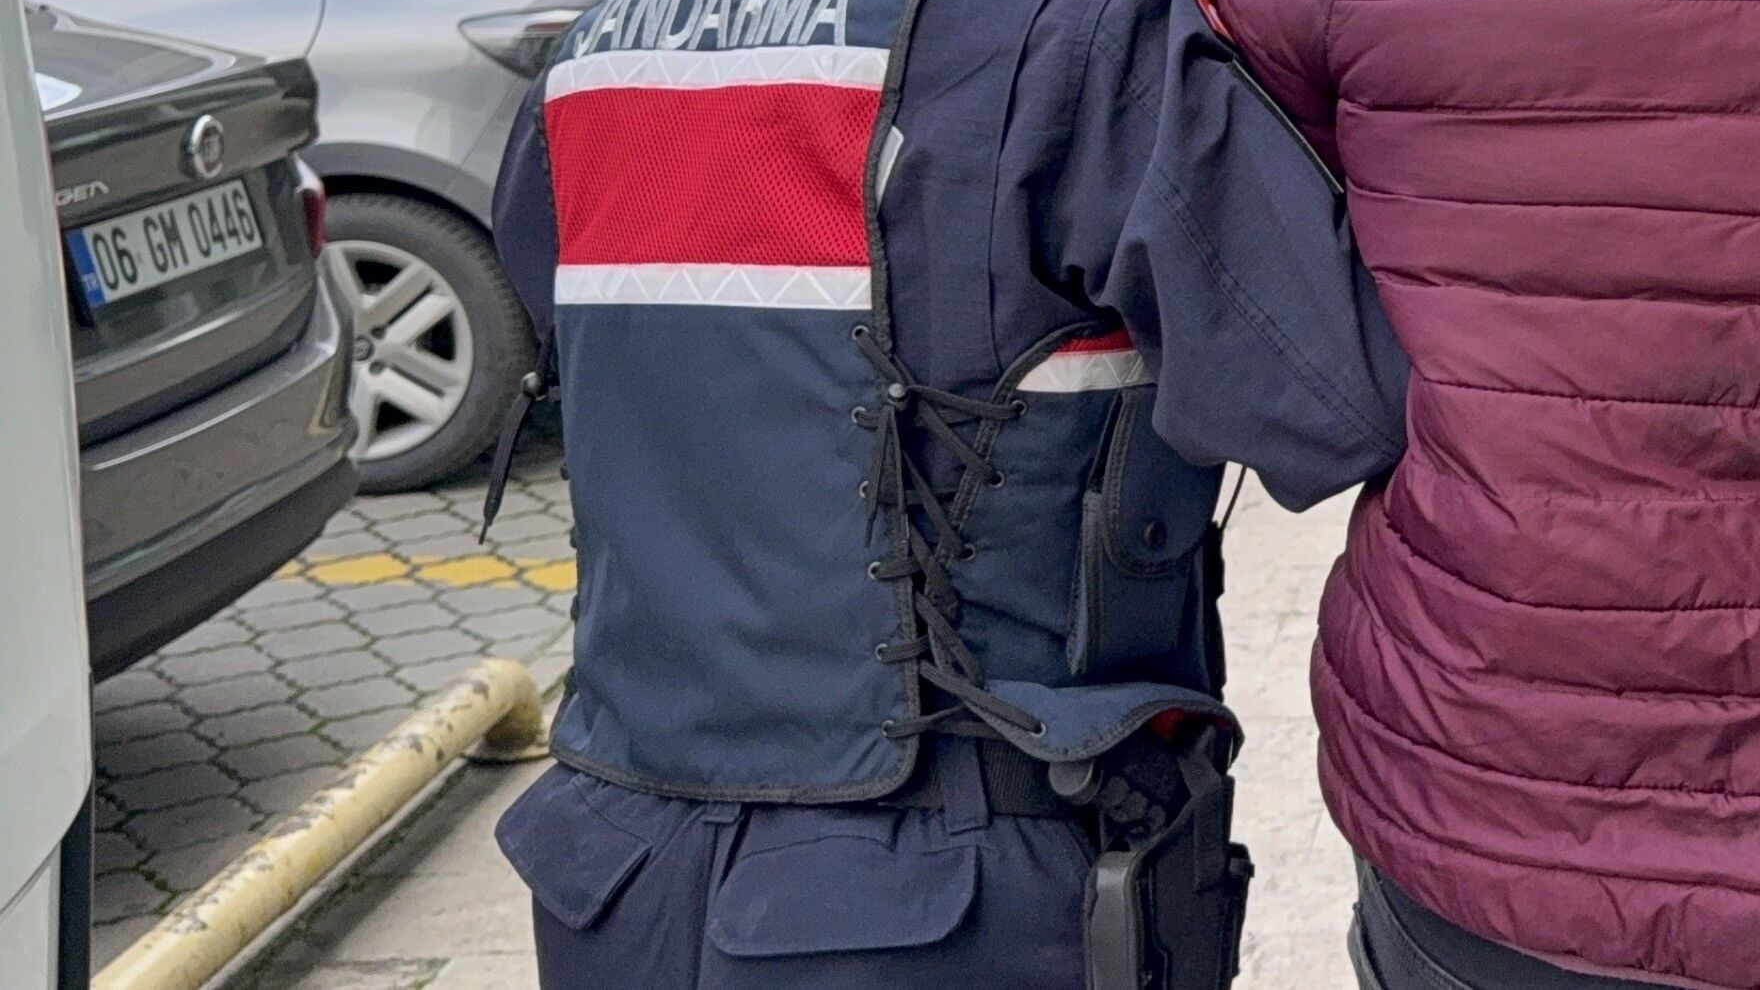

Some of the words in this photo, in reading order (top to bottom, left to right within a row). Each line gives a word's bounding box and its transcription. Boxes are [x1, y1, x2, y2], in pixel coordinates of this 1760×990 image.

[92, 226, 138, 290] 06
[143, 210, 189, 274] GM
[187, 188, 255, 258] 0446
